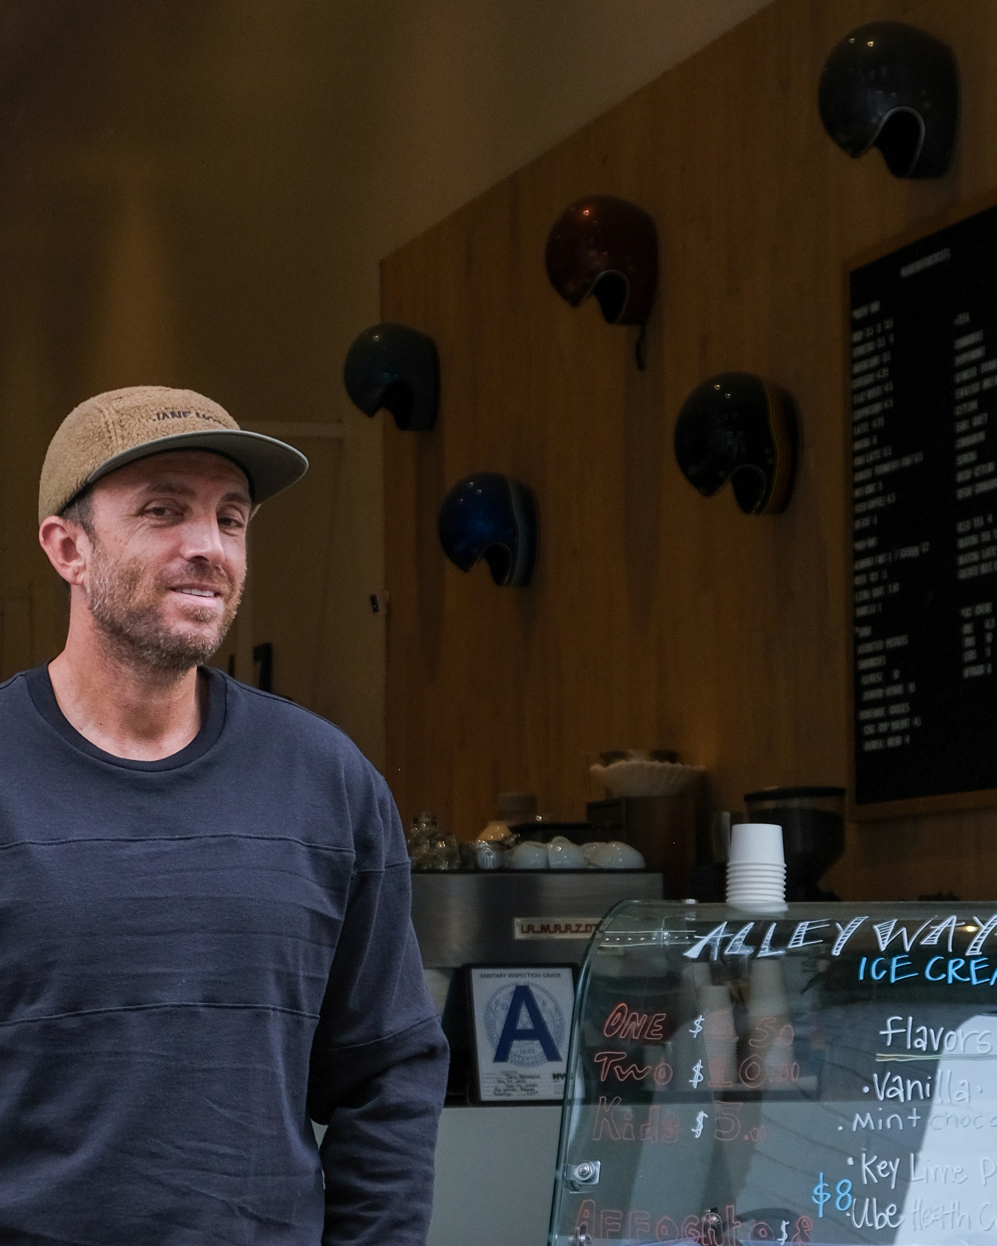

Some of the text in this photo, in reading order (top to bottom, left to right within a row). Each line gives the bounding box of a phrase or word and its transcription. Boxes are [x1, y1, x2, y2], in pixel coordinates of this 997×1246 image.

[859, 954, 919, 984] ICE
[493, 985, 563, 1063] A
[861, 1151, 900, 1190] Key
[910, 1151, 968, 1185] Lime
[812, 1172, 853, 1218] $8
